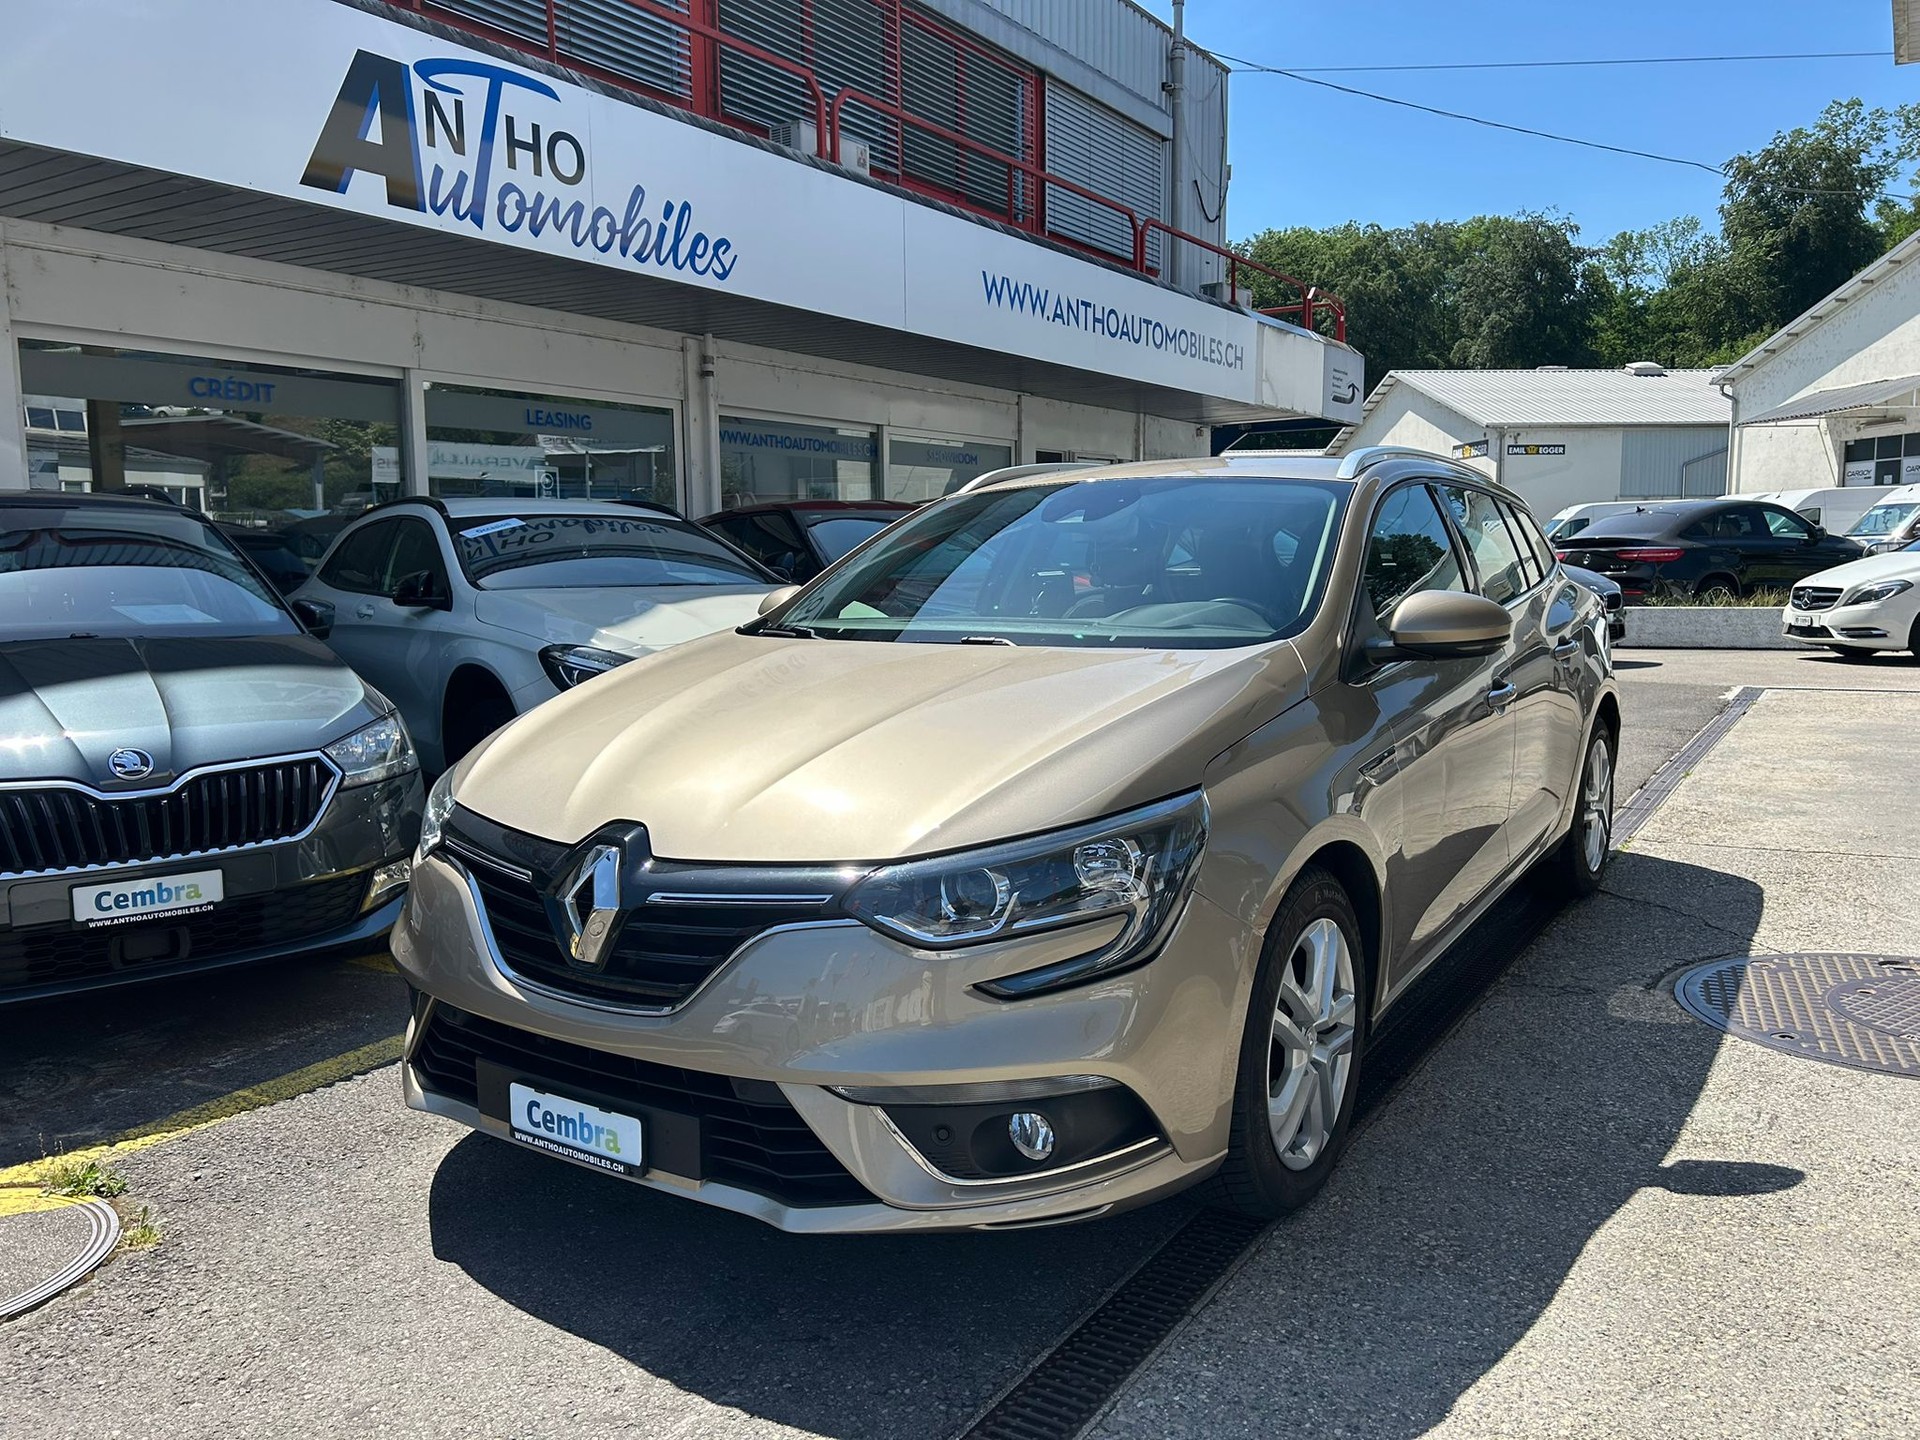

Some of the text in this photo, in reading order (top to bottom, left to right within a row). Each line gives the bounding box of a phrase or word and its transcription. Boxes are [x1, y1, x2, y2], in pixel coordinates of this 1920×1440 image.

[982, 270, 1244, 370] WWW.ANTHOAUTOMOBILES.CH
[189, 376, 276, 402] CRÉDIT
[526, 408, 592, 430] LEASING
[1508, 446, 1564, 455] EMIL EGGER
[94, 882, 202, 912] Cembra
[88, 904, 214, 929] WWW.ANTHOAUTOMOBILES.CH
[526, 1100, 621, 1154] Cembra
[514, 1131, 624, 1173] WWW.ANTHOAUTOMOBILES.CH
